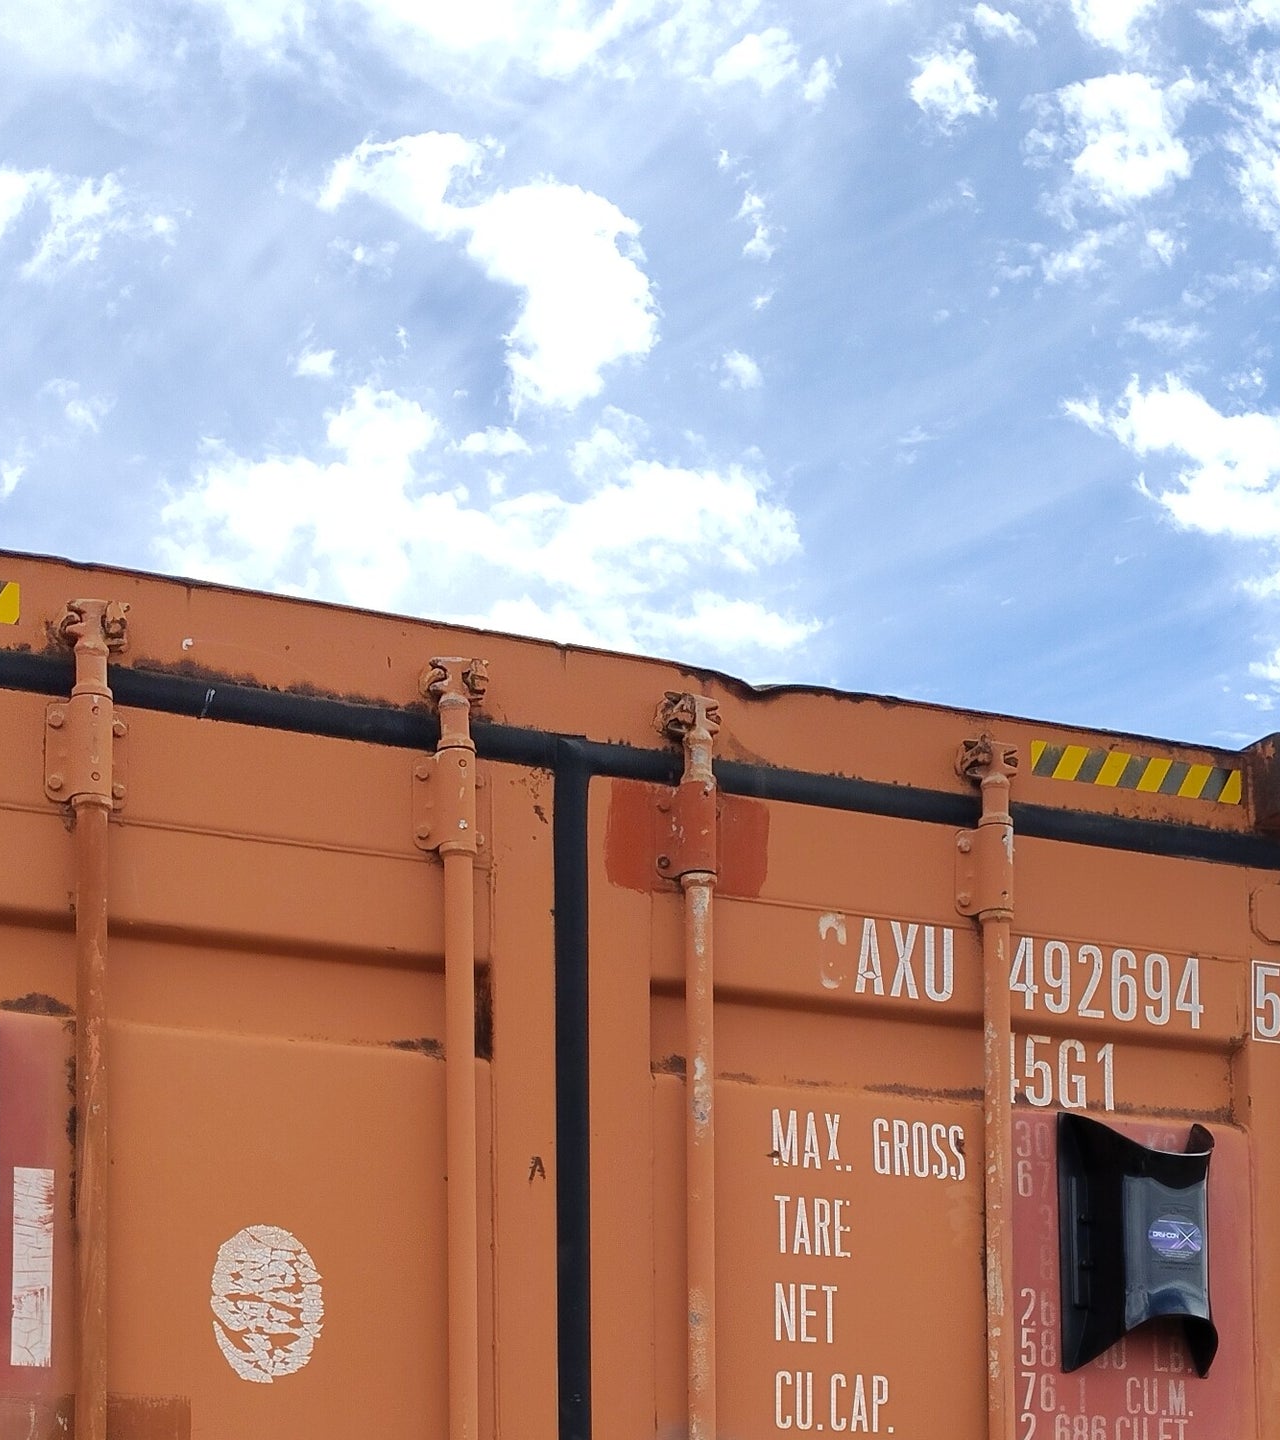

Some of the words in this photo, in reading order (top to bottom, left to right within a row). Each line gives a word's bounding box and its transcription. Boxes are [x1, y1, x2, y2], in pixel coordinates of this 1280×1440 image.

[1010, 936, 1205, 1030] 492694
[1010, 1033, 1115, 1111] 5G1
[771, 1109, 852, 1172] MAX.
[872, 1118, 966, 1181] GROSS
[774, 1195, 852, 1259] TARE
[774, 1283, 838, 1344] NET
